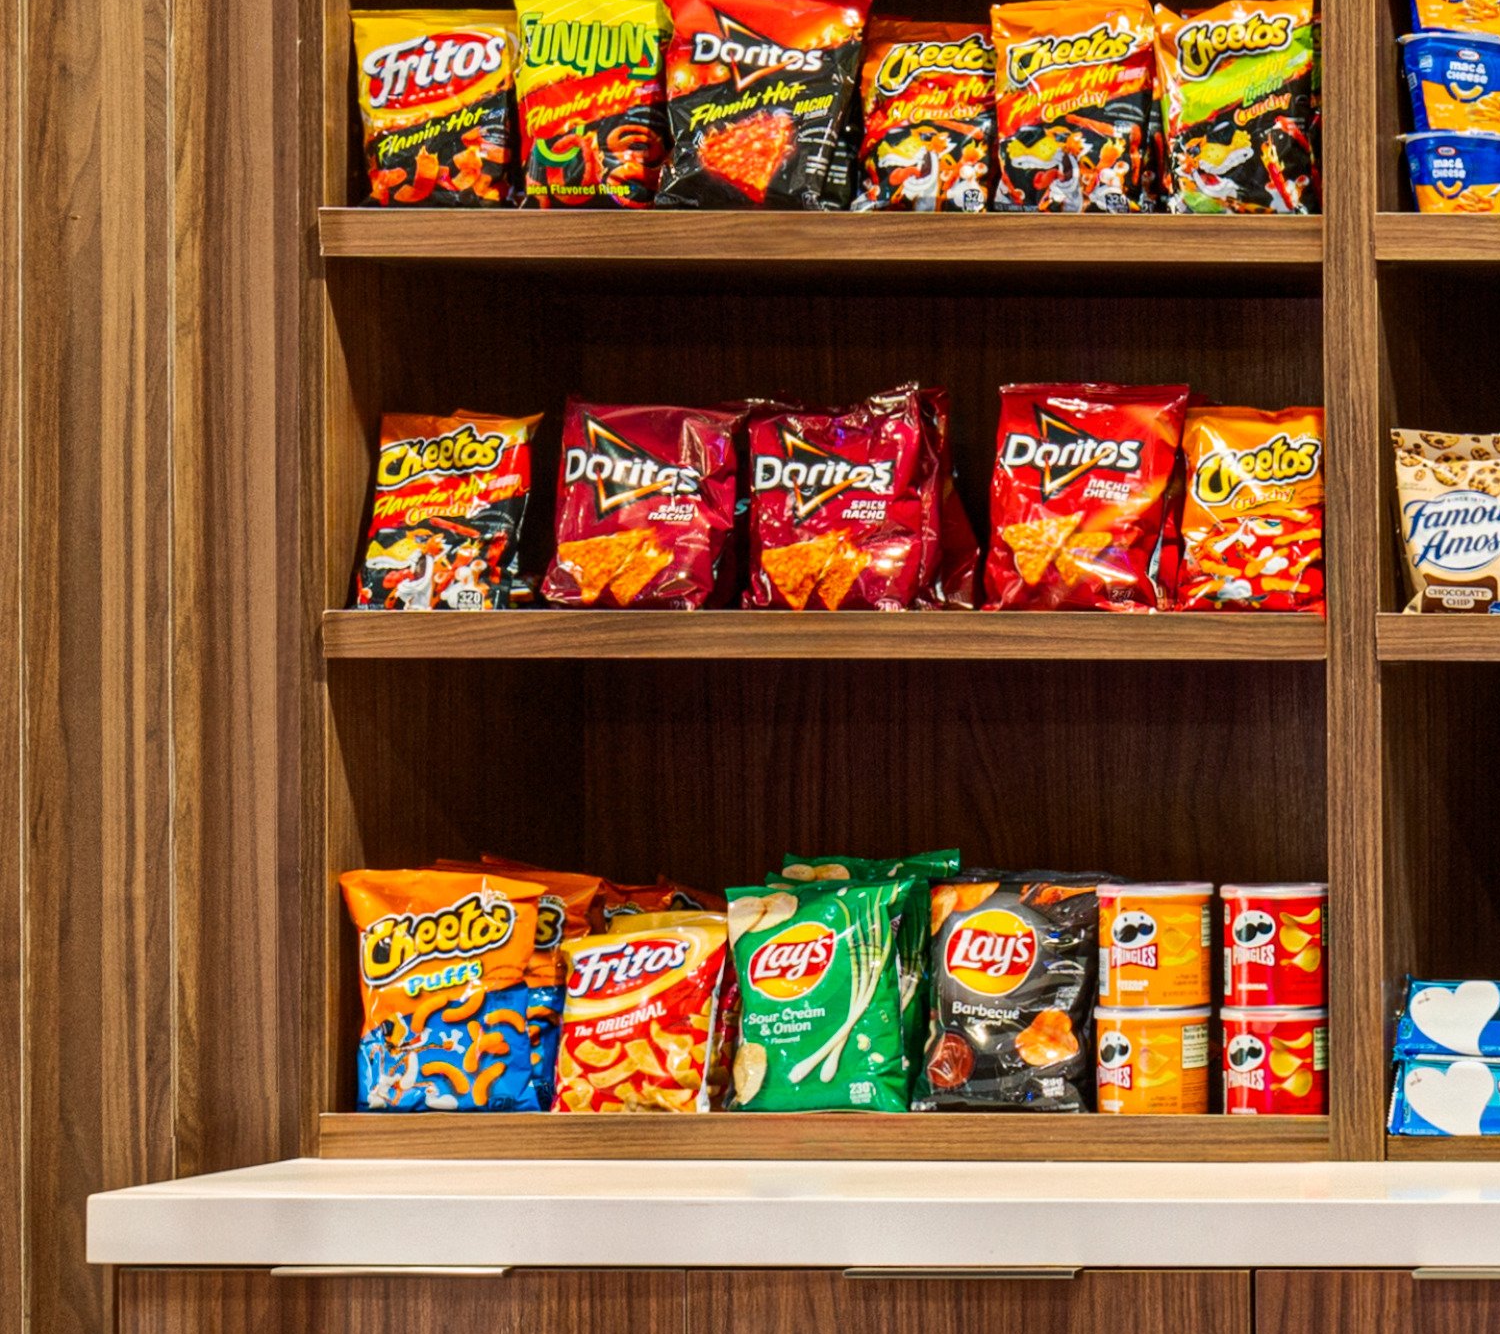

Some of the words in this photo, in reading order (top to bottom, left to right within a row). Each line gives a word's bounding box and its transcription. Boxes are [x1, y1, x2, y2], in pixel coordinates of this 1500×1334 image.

[694, 34, 823, 71] Doritos
[1008, 29, 1135, 86] Cheetos
[1179, 17, 1290, 78] Cheetos
[363, 35, 503, 108] Fritos
[597, 79, 641, 104] Hot
[762, 82, 804, 103] Hot
[1041, 90, 1108, 122] Crunchy
[443, 108, 489, 128] Hot
[1233, 93, 1291, 125] Crunchy
[550, 185, 595, 196] Flavored
[377, 430, 502, 488] Cheetos
[1004, 434, 1142, 469] Doritos
[755, 455, 892, 490] Doritos
[1088, 479, 1130, 492] NACHO
[1196, 435, 1320, 506] Cheetos
[1083, 487, 1129, 501] CHEESE
[843, 509, 885, 521] NACHO
[1414, 530, 1500, 570] Amos
[459, 592, 481, 603] 320
[1428, 588, 1489, 599] CHOCOLATE
[1446, 598, 1472, 608] CHIP
[365, 901, 512, 980] Cheetos
[951, 929, 1032, 975] Lay's
[1112, 945, 1157, 968] PRINGLES
[1233, 945, 1275, 966] PRINGLES
[569, 939, 690, 997] Fritos
[756, 935, 833, 981] Lay's
[406, 962, 482, 995] Puffs
[574, 1024, 592, 1036] The
[595, 1002, 667, 1034] ORIGINAL
[749, 1012, 780, 1025] Sour
[782, 1007, 826, 1021] Cream
[774, 1019, 811, 1033] Onion
[952, 1001, 1020, 1020] Barbecue
